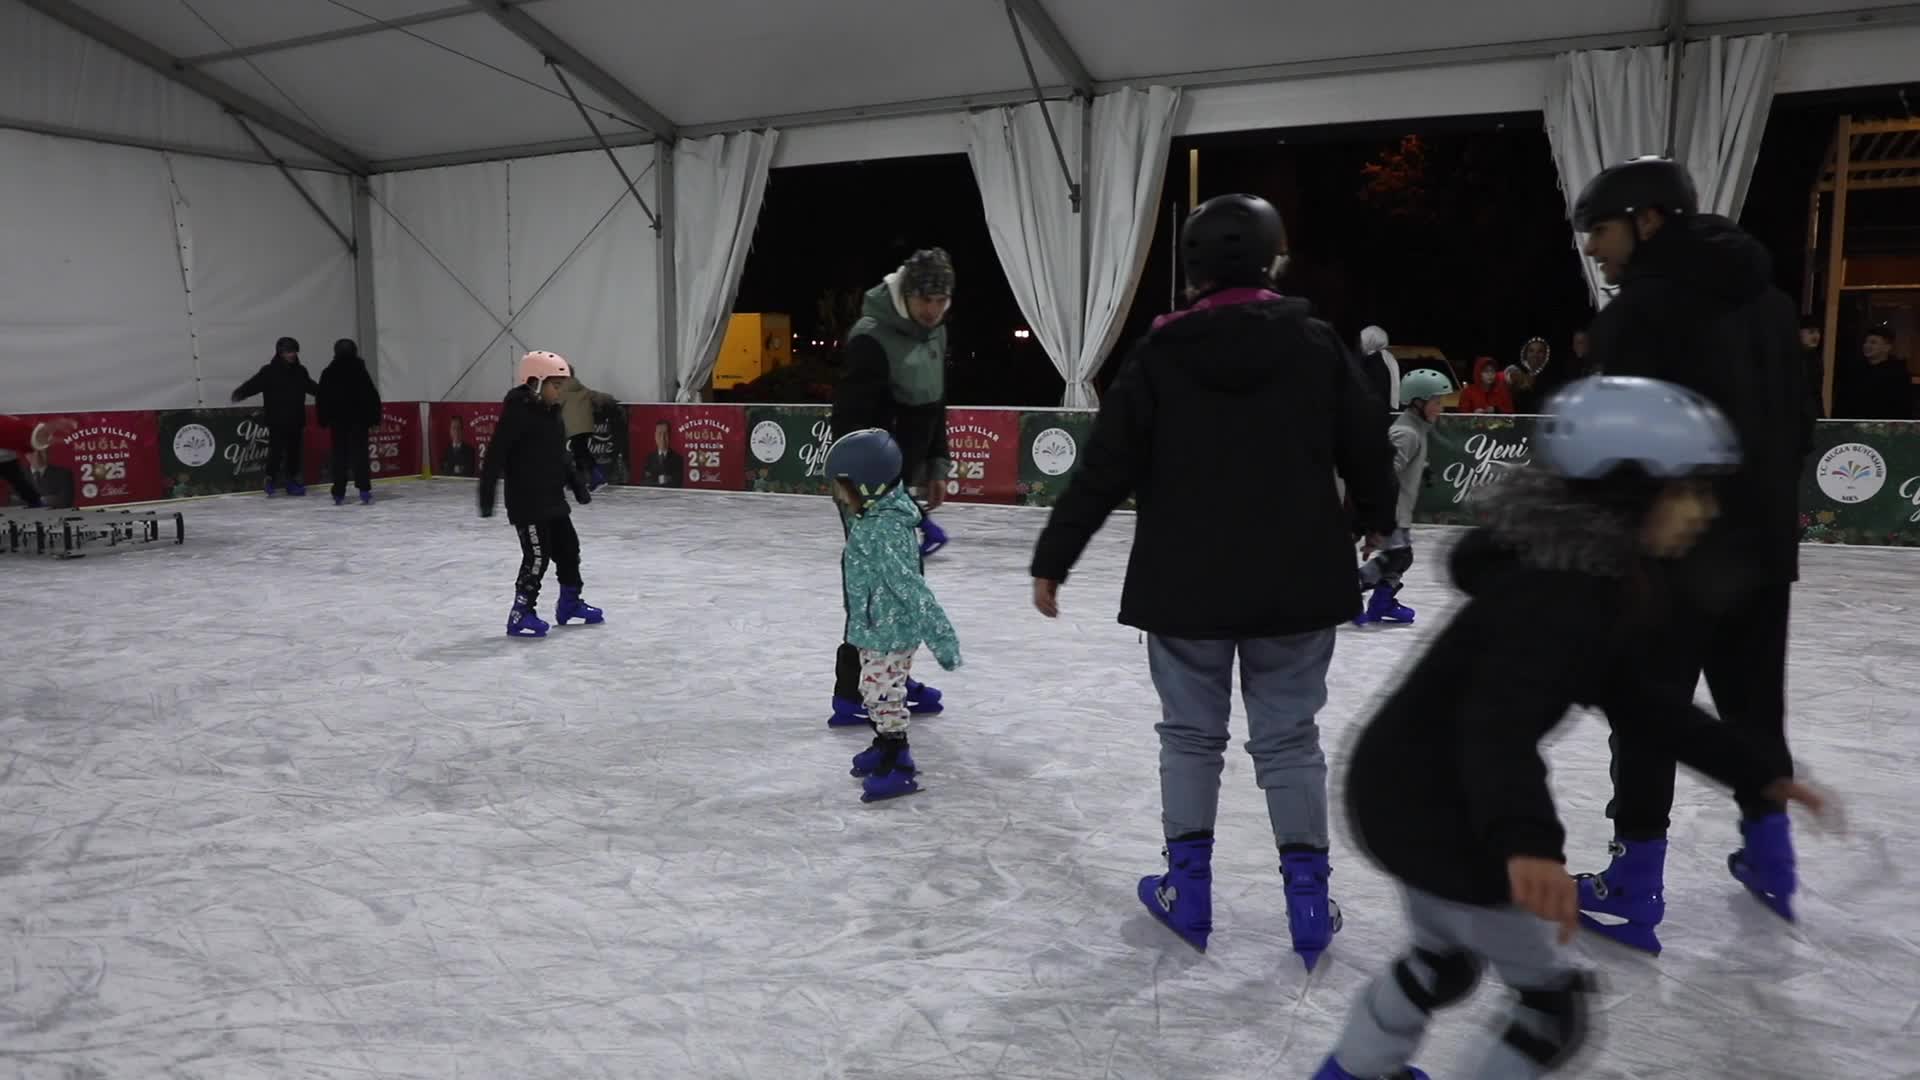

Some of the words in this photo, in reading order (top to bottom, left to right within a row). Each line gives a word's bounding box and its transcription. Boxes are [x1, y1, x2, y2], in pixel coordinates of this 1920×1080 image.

[64, 427, 98, 445] MUTLU
[101, 427, 137, 440] YILLAR
[237, 420, 270, 450] Yen
[685, 429, 722, 440] MUĞLA
[946, 425, 966, 435] TLU
[968, 425, 999, 442] YILLAR
[74, 438, 129, 450] MUĞLA
[74, 454, 93, 462] HOŞ
[96, 451, 130, 460] GELDİN
[949, 451, 960, 460] OŞ
[1464, 434, 1531, 473] Yeni
